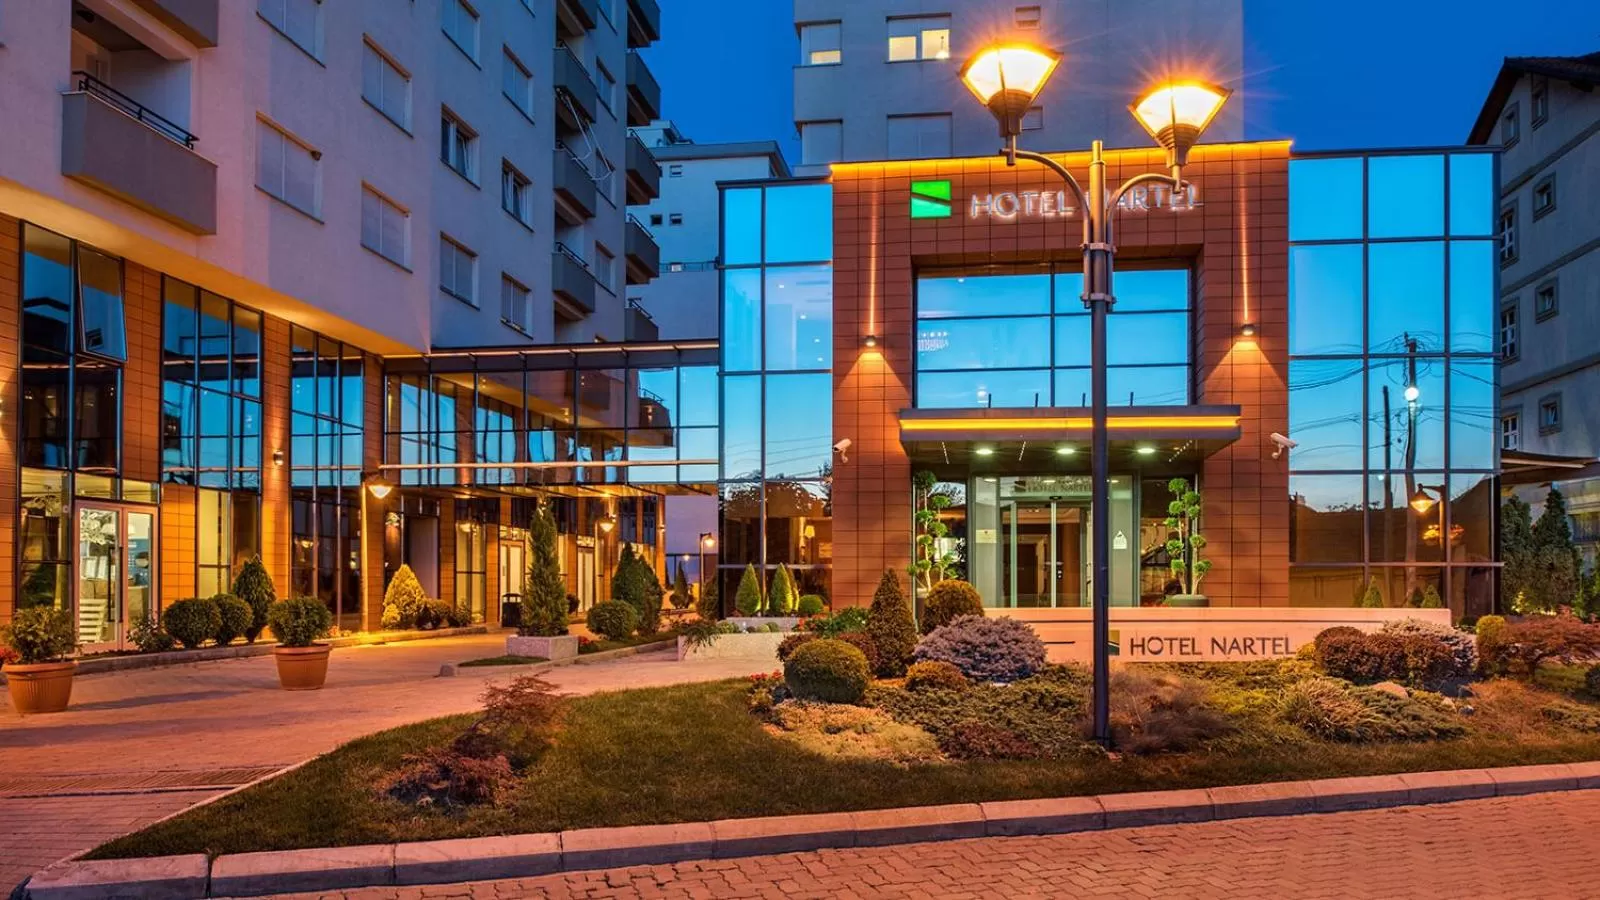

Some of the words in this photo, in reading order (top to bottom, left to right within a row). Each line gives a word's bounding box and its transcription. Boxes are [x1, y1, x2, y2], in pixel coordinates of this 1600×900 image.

[970, 191, 1074, 217] HOTEL
[1130, 637, 1203, 656] HOTEL
[1210, 637, 1297, 656] NARTEL
